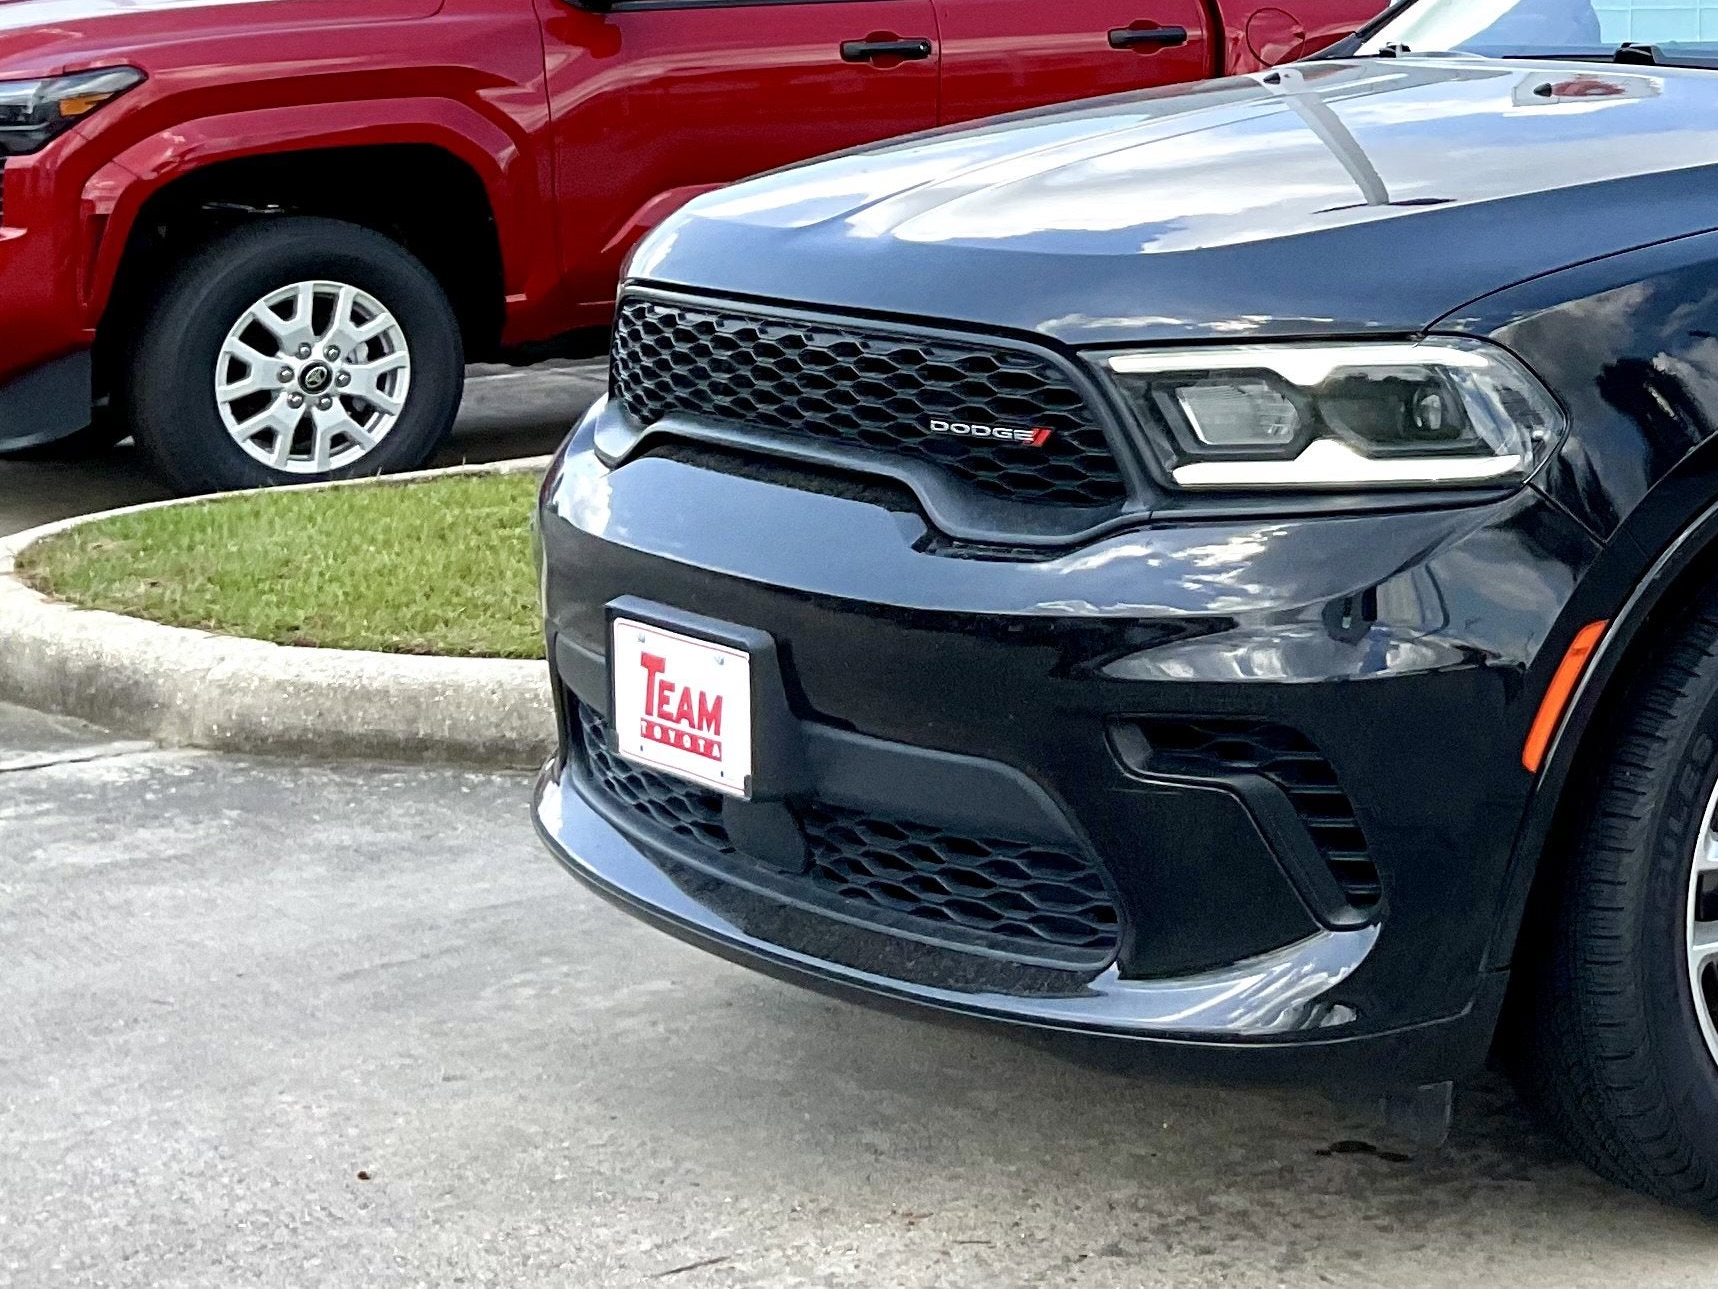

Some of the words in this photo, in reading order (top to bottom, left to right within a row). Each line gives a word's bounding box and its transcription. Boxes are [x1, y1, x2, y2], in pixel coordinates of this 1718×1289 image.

[929, 419, 1036, 442] DODGE
[640, 651, 723, 736] TEAM
[640, 720, 722, 760] TOYOTA
